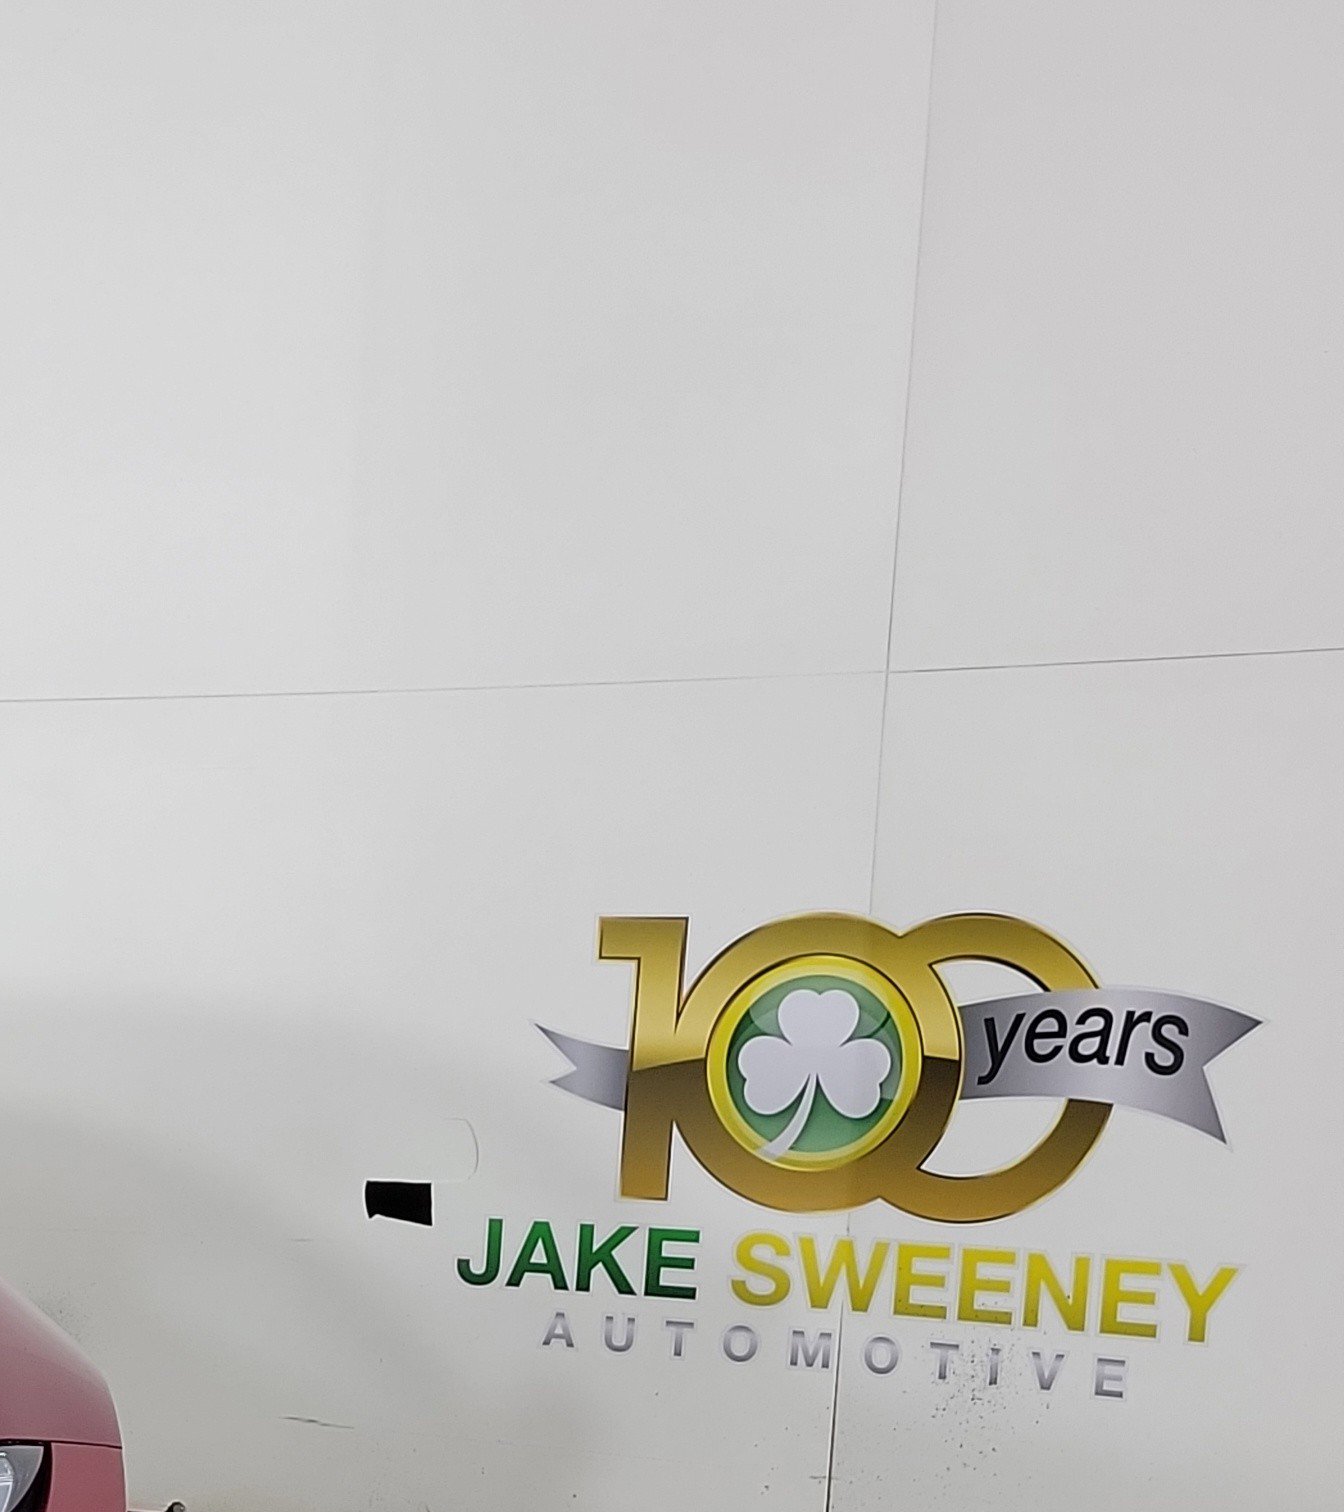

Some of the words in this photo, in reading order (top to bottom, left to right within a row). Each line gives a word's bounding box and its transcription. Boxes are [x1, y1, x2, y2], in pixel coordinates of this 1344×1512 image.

[979, 1007, 1189, 1085] years
[455, 1218, 701, 1300] JAKE
[730, 1233, 1239, 1344] SWEENEY
[542, 1312, 1129, 1400] AUTOMOTIVE
